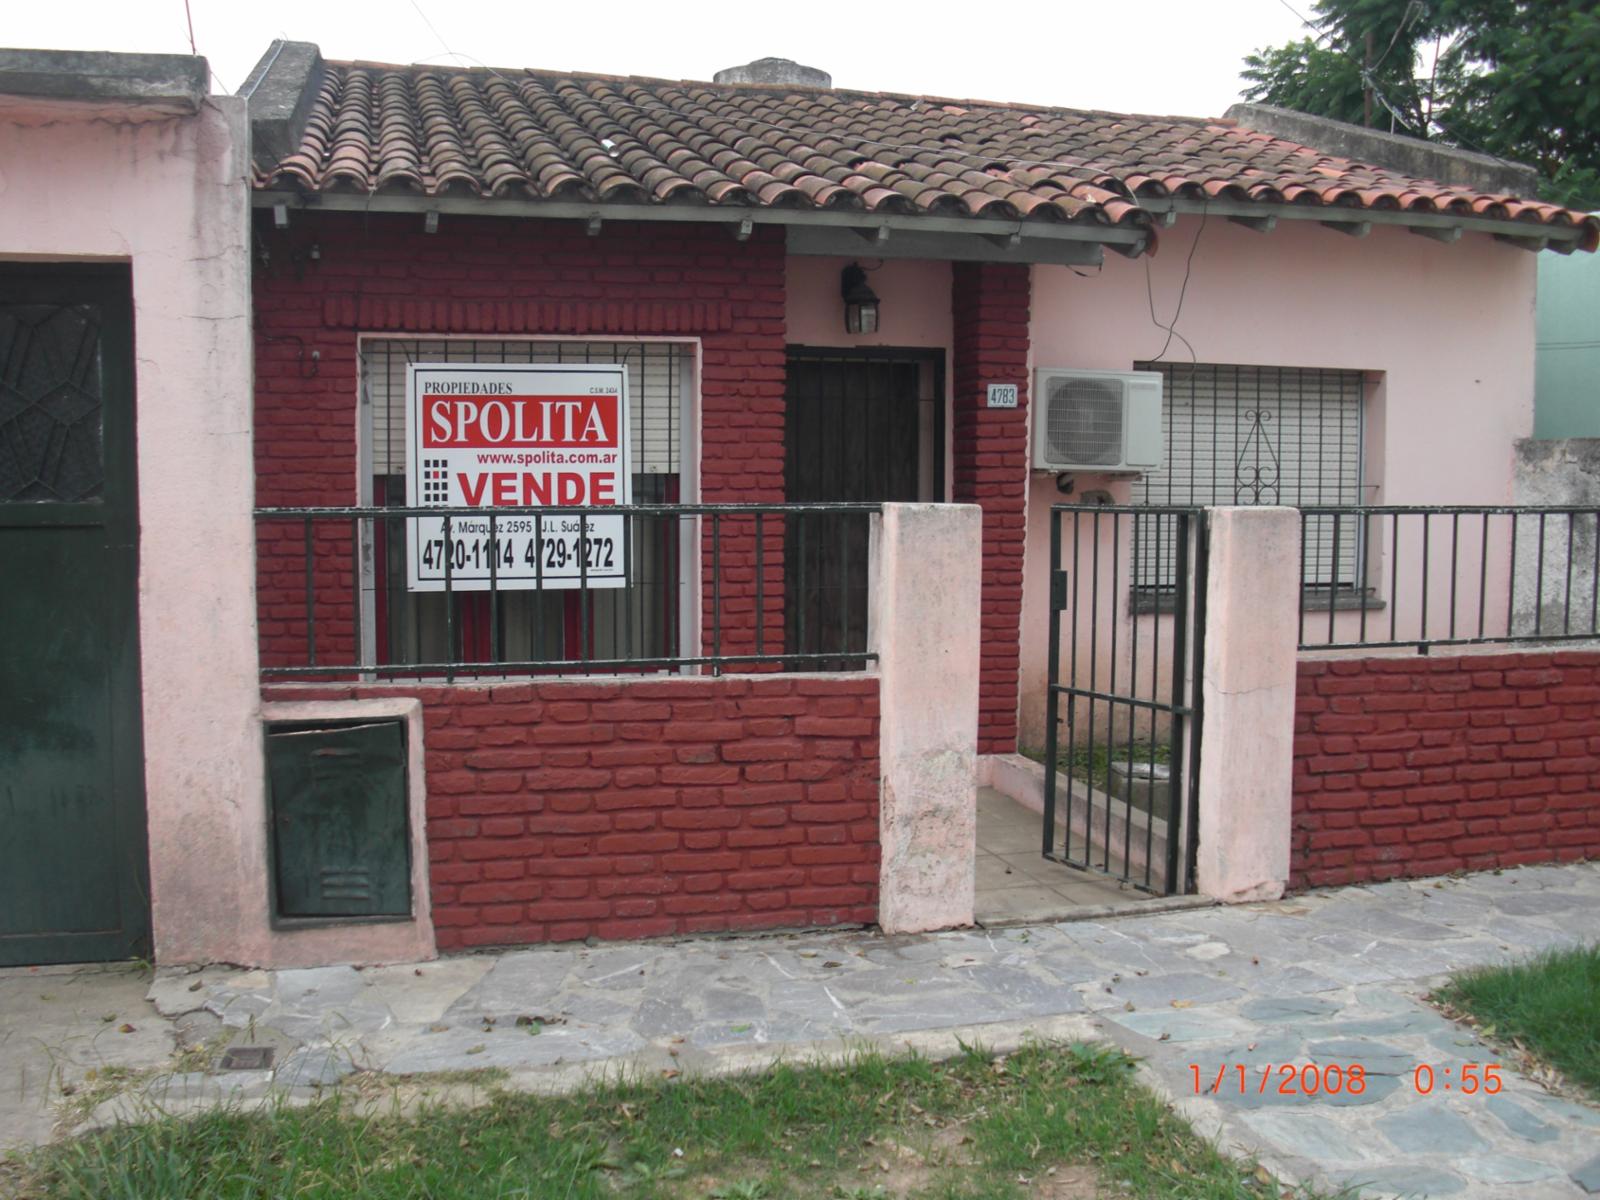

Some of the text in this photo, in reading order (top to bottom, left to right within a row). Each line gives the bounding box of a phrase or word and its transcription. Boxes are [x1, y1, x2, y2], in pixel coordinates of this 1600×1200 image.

[424, 382, 513, 395] PROPIEDADES
[991, 388, 1015, 404] 4783
[431, 401, 609, 443] SPOLITA
[477, 451, 618, 467] www.spolita.com.ar
[456, 471, 616, 506] VENDE
[506, 520, 532, 533] 2595
[542, 520, 559, 533] J.L.
[561, 519, 595, 533] Suáez
